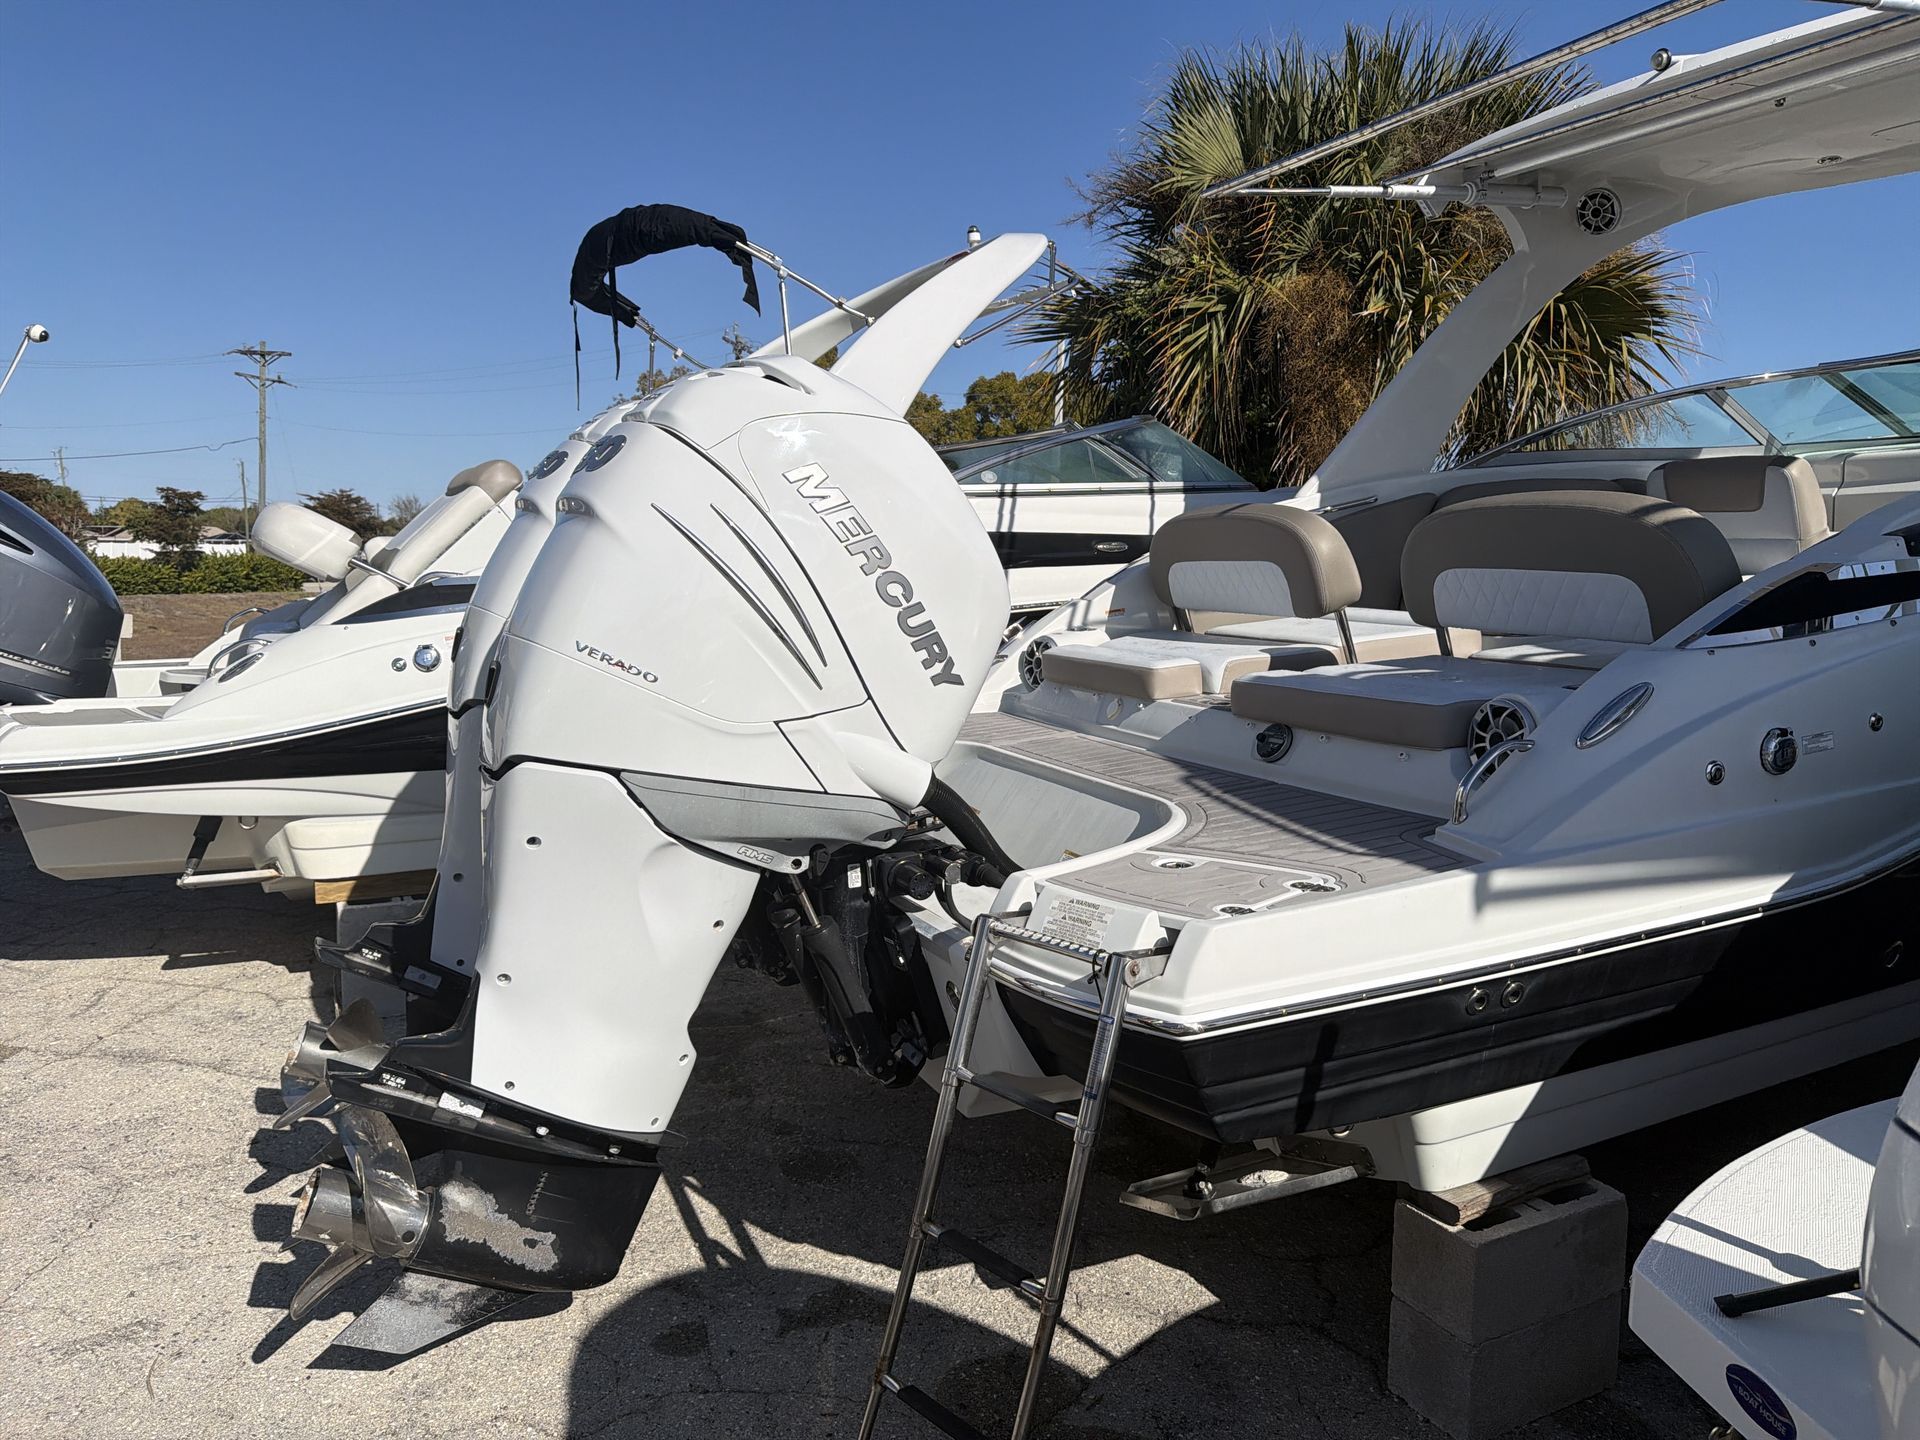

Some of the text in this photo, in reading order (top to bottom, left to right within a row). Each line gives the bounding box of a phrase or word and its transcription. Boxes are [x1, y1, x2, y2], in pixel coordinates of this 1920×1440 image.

[781, 462, 965, 687] MERCURY
[575, 640, 659, 683] VERADO
[737, 845, 774, 864] AMS
[1075, 899, 1101, 910] WARNING
[1068, 916, 1092, 927] WARNING
[1760, 1406, 1787, 1435] HOUSE
